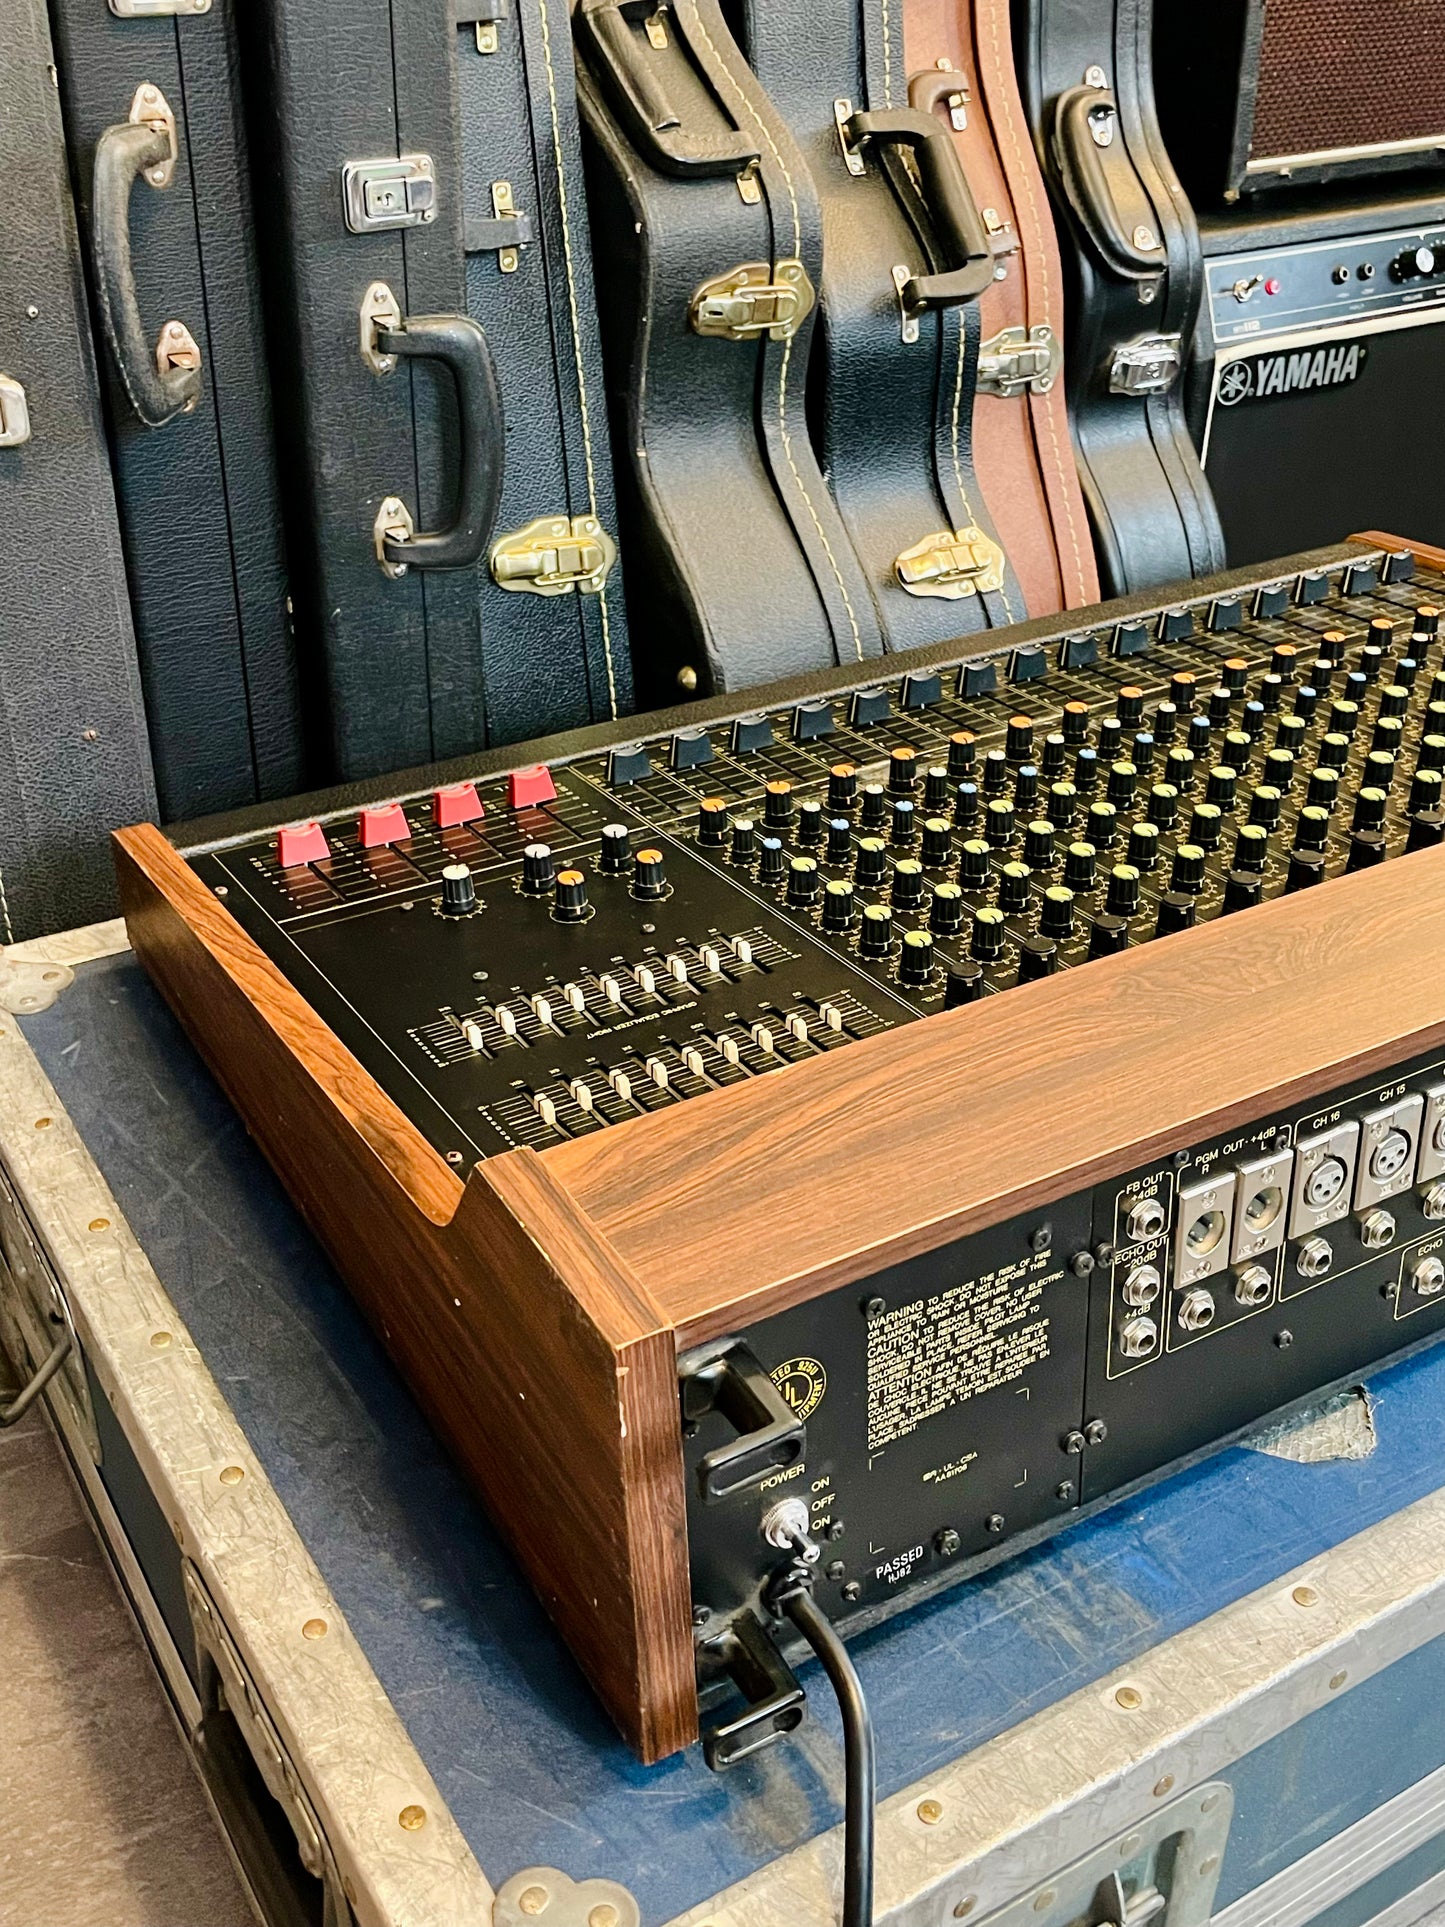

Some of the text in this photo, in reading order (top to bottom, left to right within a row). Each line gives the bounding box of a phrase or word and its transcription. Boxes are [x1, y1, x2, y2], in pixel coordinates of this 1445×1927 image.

[1256, 345, 1359, 396] YAMAHA
[613, 1009, 660, 1033] EQUALIZER
[1379, 1084, 1406, 1102] CH 15
[1312, 1110, 1340, 1129] CH 16
[1195, 1148, 1219, 1166] PGM
[1250, 1126, 1276, 1143] +4dB
[1261, 1141, 1266, 1150] L
[1126, 1170, 1164, 1194] FB OUT
[1202, 1164, 1210, 1174] R
[1131, 1184, 1158, 1201] +4dB
[1114, 1234, 1168, 1264] ECHO OUT
[1418, 1238, 1442, 1256] ECHO
[867, 1249, 1050, 1331] WARNING TO REDUCE THE RISK OF FIRE
[867, 1329, 879, 1339] OR
[884, 1311, 922, 1332] ELECTRIC
[959, 1291, 970, 1301] DO
[975, 1282, 991, 1294] NOT
[995, 1268, 1025, 1286] EXPOSE
[1030, 1259, 1046, 1271] THIS
[867, 1270, 1064, 1358] CAUTION TO REDUCE THE RISK OF ELECTRIC
[867, 1323, 911, 1347] APPLIANCE
[916, 1317, 926, 1327] TO
[931, 1307, 949, 1320] RAIN
[954, 1301, 965, 1311] OR
[901, 1342, 913, 1352] DO
[918, 1333, 934, 1345] NOT
[937, 1318, 970, 1337] REMOVE
[1006, 1298, 1017, 1308] NO
[1021, 1288, 1041, 1302] USER
[1124, 1303, 1151, 1319] +4dB
[867, 1360, 910, 1383] SOLDERED
[914, 1355, 922, 1363] IN
[957, 1329, 982, 1345] REFER
[987, 1310, 1026, 1332] SERVICING
[1030, 1304, 1039, 1314] TO
[867, 1347, 921, 1375] SERVICEABLE
[926, 1335, 950, 1350] PARTS
[867, 1368, 931, 1401] ATTENTION
[957, 1353, 967, 1363] DE
[1008, 1332, 1017, 1341] LE
[868, 1400, 878, 1410] DE
[883, 1388, 906, 1403] CHOC
[964, 1359, 973, 1368] NE
[978, 1351, 992, 1362] PAS
[996, 1334, 1030, 1354] ENLEVER
[1034, 1328, 1043, 1337] LE
[868, 1369, 908, 1391] QUALIFIED
[912, 1353, 945, 1372] SERVICE
[932, 1380, 942, 1390] NE
[946, 1374, 956, 1384] SE
[960, 1359, 990, 1378] TROUVE
[868, 1406, 900, 1426] AUCUNE
[931, 1378, 966, 1398] POUVANT
[1032, 1343, 1046, 1354] PAR
[910, 1405, 920, 1415] LA
[925, 1392, 951, 1409] LAMPE
[988, 1370, 1001, 1381] EST
[1040, 1349, 1049, 1358] EN
[960, 1391, 970, 1401] UN
[960, 1452, 978, 1464] CSA
[760, 1464, 805, 1492] POWER
[811, 1476, 830, 1492] ON
[812, 1494, 836, 1512] OFF
[812, 1516, 830, 1530] ON
[876, 1545, 924, 1580] PASSED
